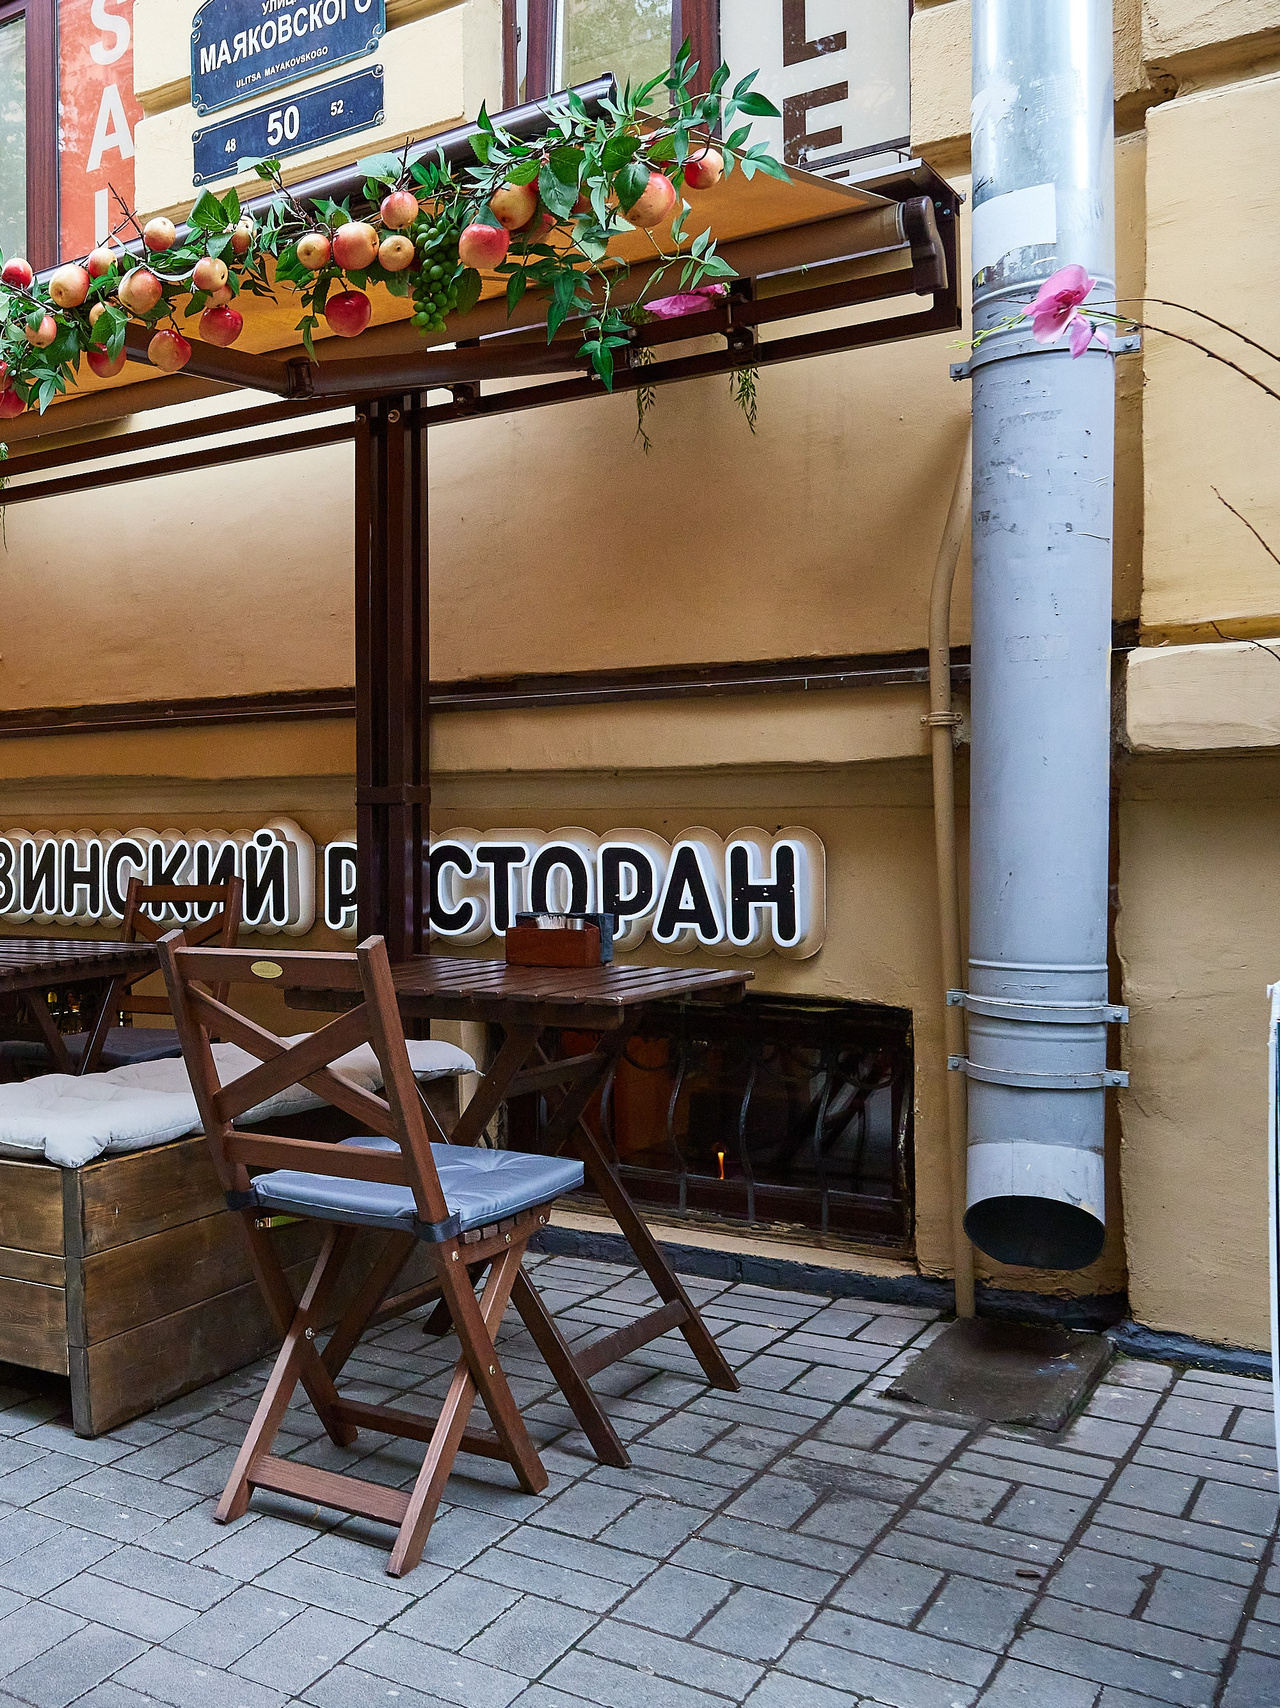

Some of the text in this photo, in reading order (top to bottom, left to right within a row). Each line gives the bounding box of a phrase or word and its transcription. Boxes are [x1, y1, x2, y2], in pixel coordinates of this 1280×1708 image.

[236, 46, 329, 88] ULITSA MAYAKOVSKOGO
[224, 100, 344, 153] 48 50 52
[323, 839, 806, 948] РСТОРАН
